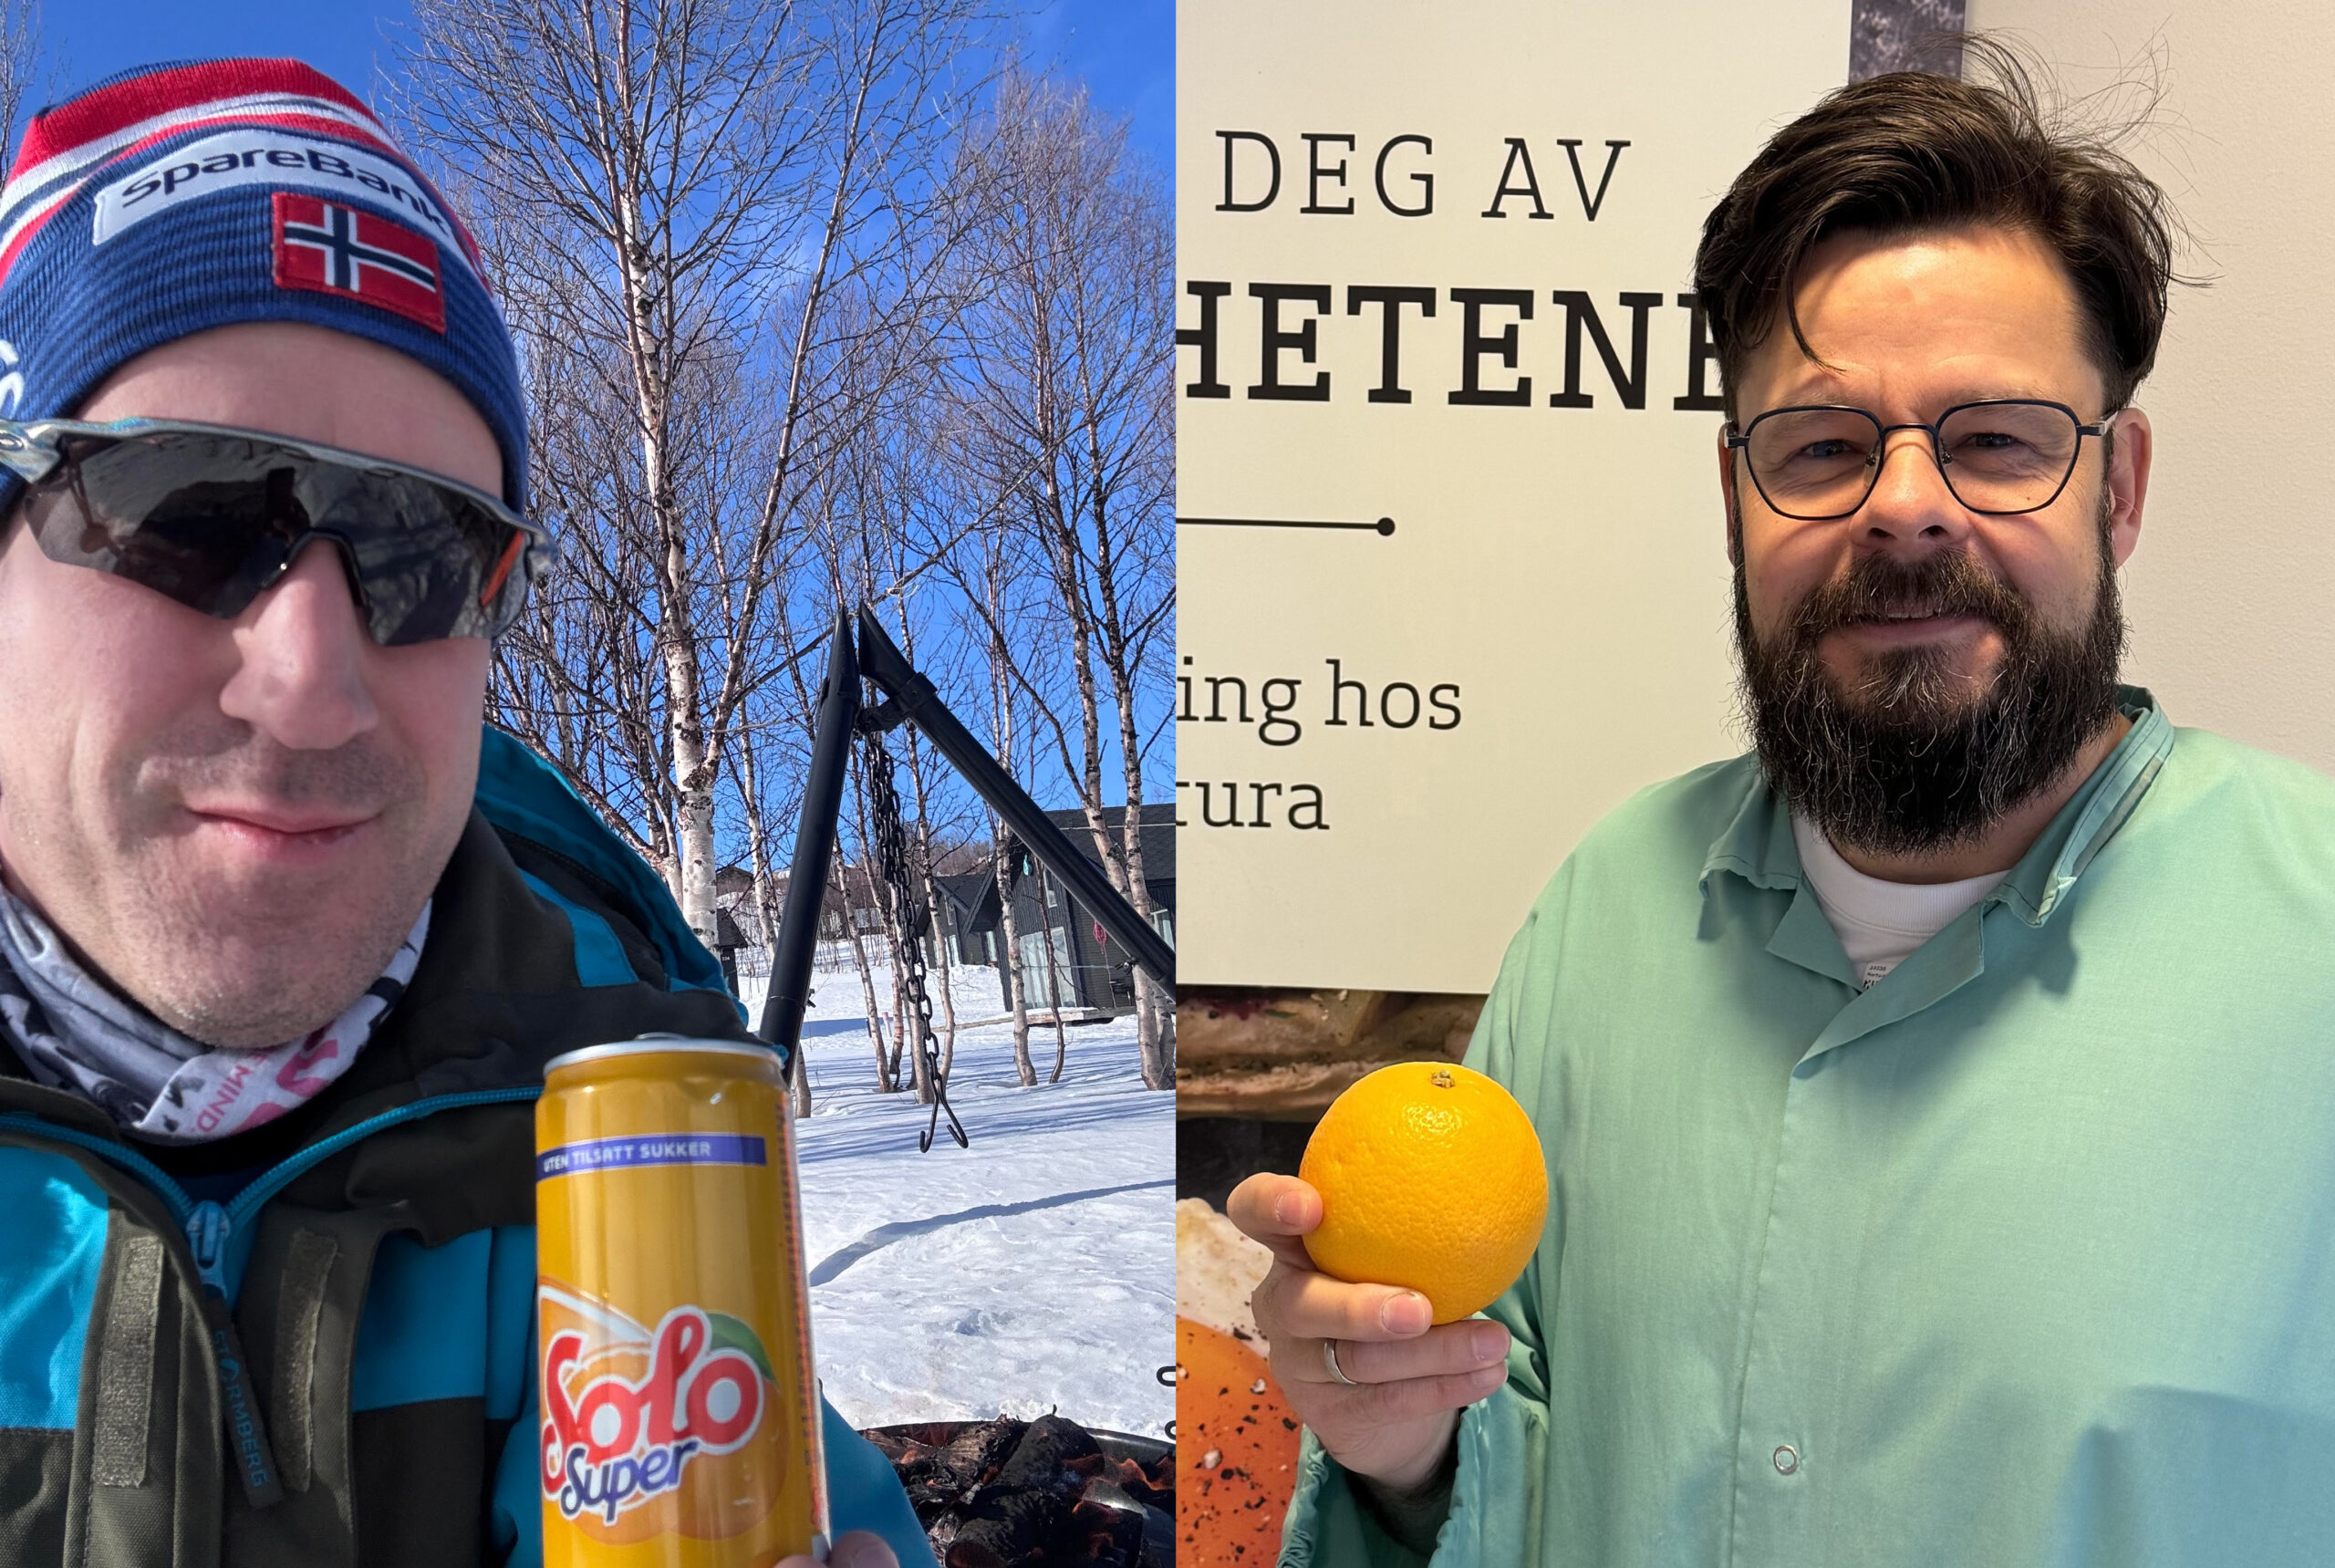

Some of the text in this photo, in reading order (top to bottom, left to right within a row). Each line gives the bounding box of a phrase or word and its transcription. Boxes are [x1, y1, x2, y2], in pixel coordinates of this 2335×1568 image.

[122, 149, 451, 235] SpareBank
[1215, 130, 1632, 222] DEG AV
[1324, 659, 1461, 730] hos
[544, 1141, 711, 1173] UTEN TILSATT SUKKER
[542, 1311, 761, 1494] Solo
[561, 1440, 699, 1523] Super
